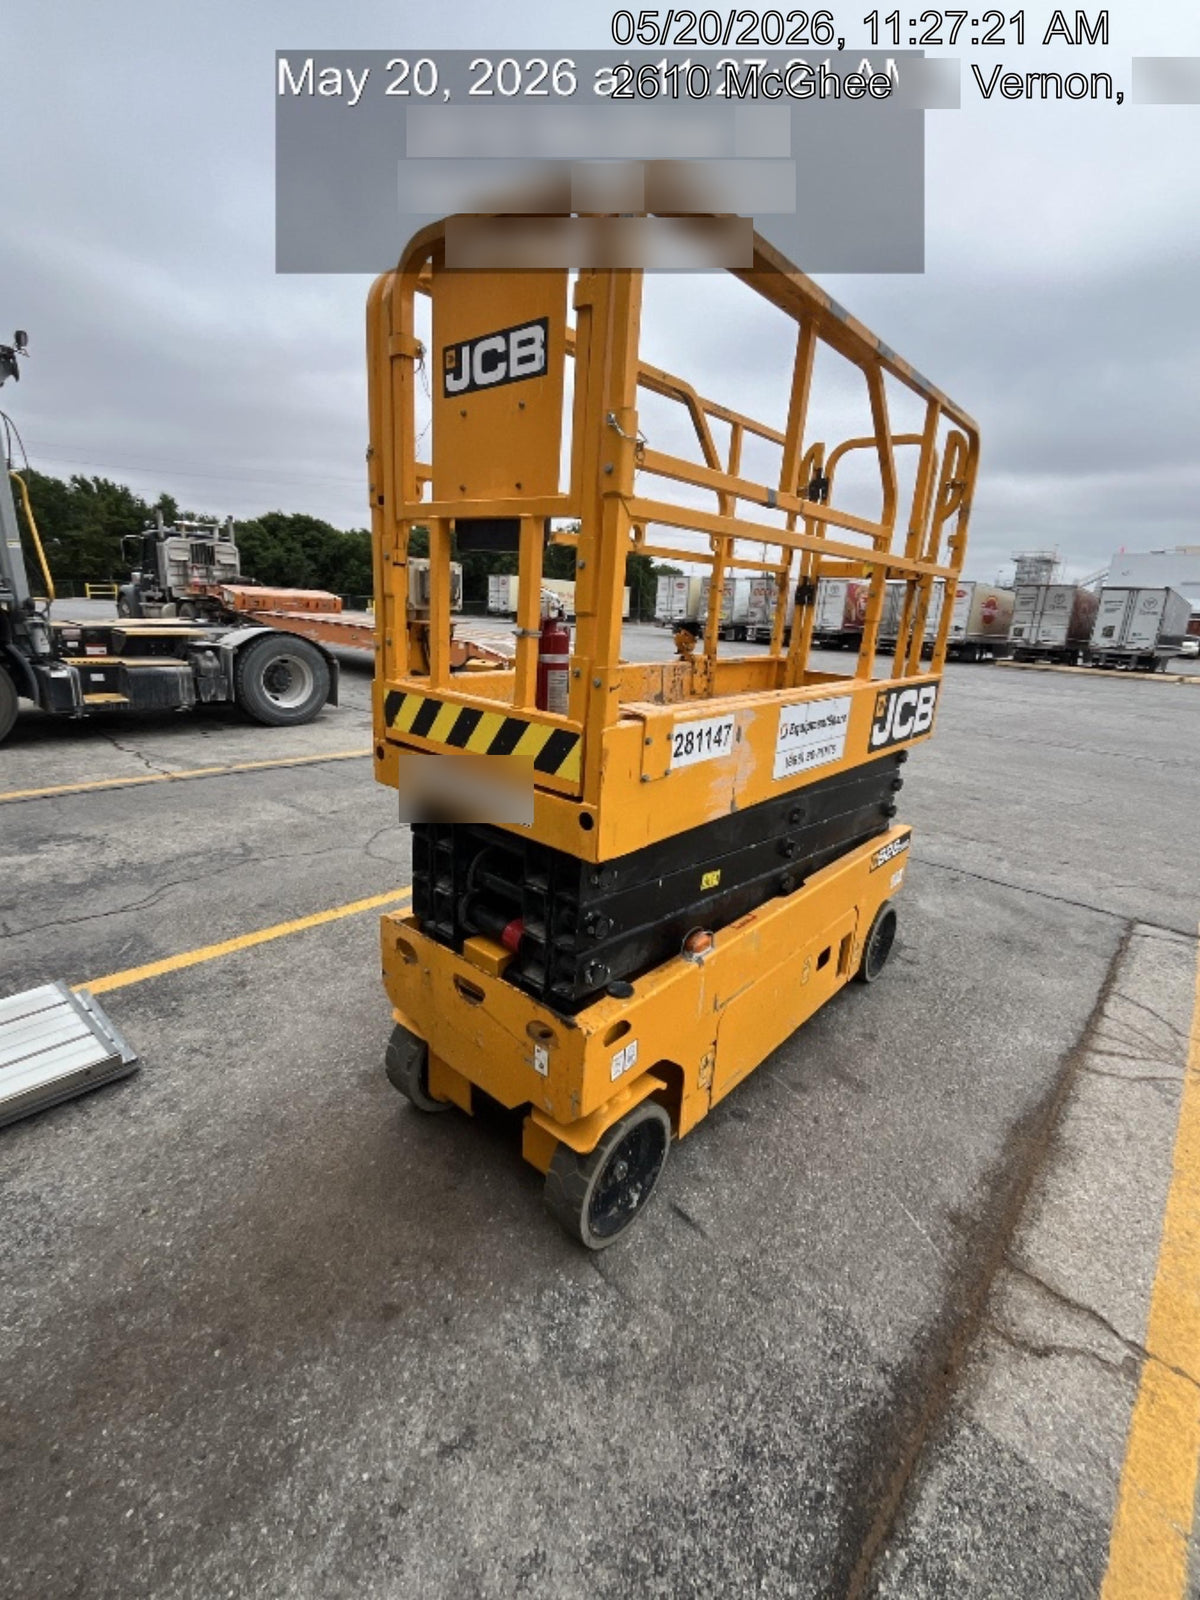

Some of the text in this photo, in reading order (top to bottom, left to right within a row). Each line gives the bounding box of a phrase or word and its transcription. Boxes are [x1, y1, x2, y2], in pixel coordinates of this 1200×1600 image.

[445, 325, 545, 392] JCB
[673, 723, 733, 759] 281147
[871, 685, 937, 747] JCB
